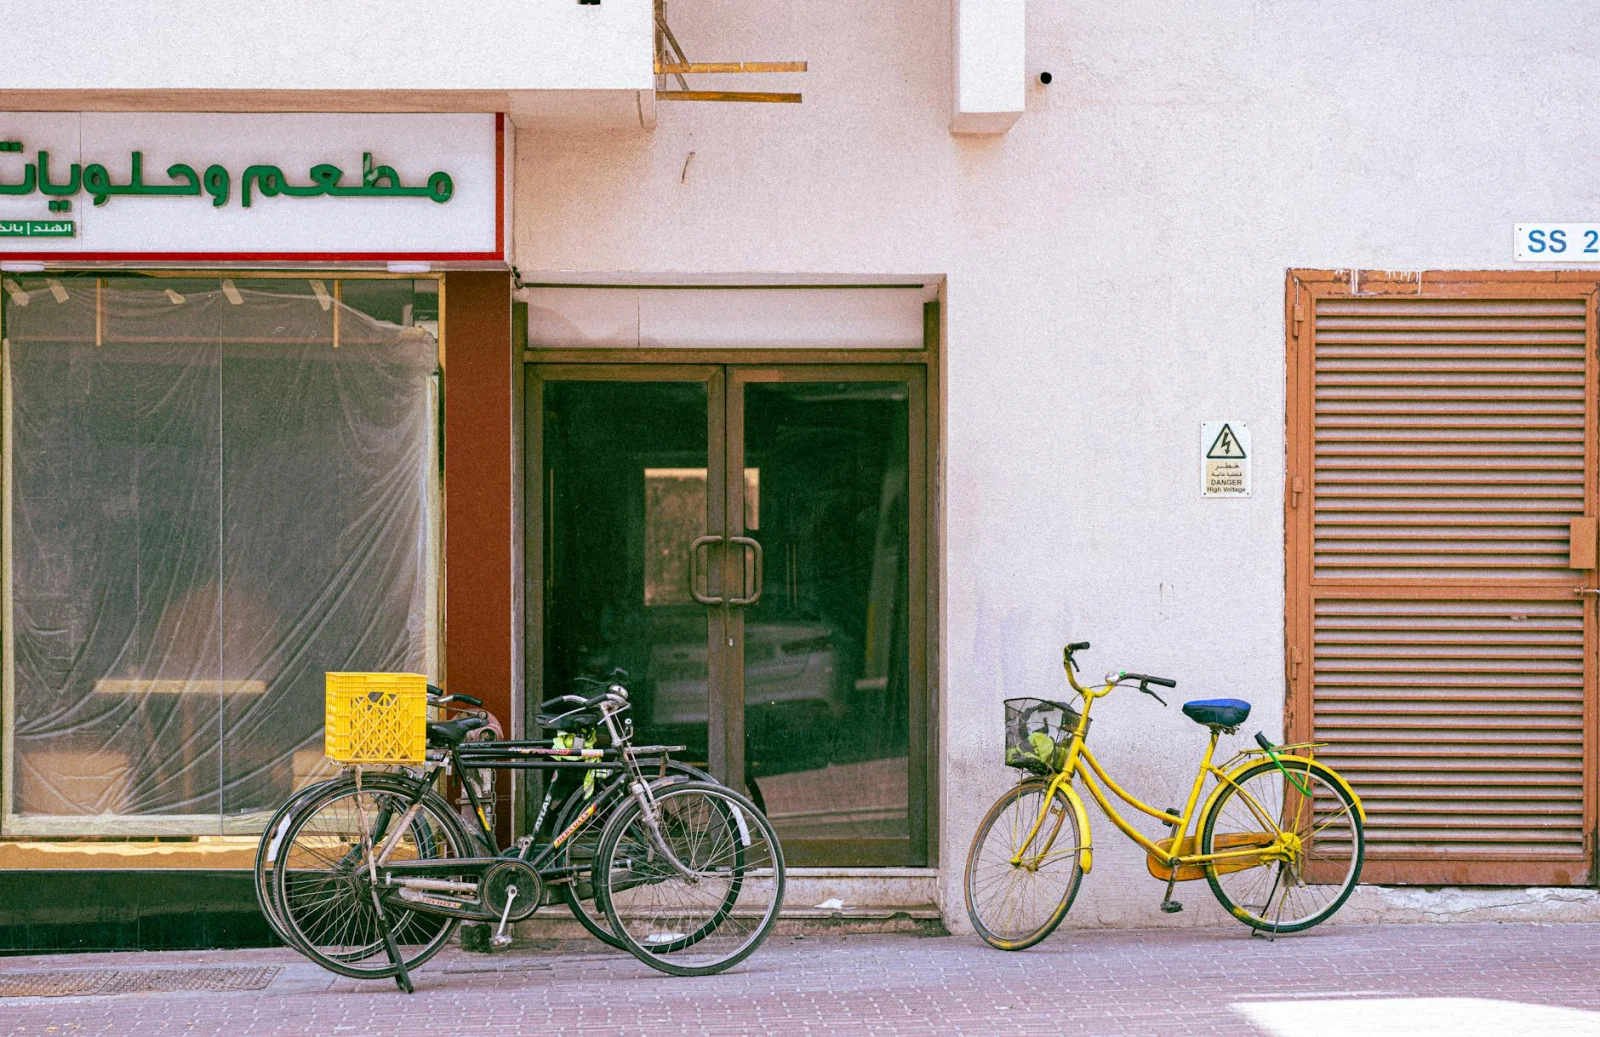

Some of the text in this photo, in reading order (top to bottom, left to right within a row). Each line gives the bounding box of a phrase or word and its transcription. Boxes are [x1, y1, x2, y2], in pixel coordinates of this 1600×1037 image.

[242, 152, 453, 208] مطعم
[33, 223, 72, 233] الهند
[1527, 229, 1567, 254] SS
[1206, 486, 1246, 494] High Voltage
[534, 792, 552, 832] ATLAS
[556, 811, 590, 844] HERCULES
